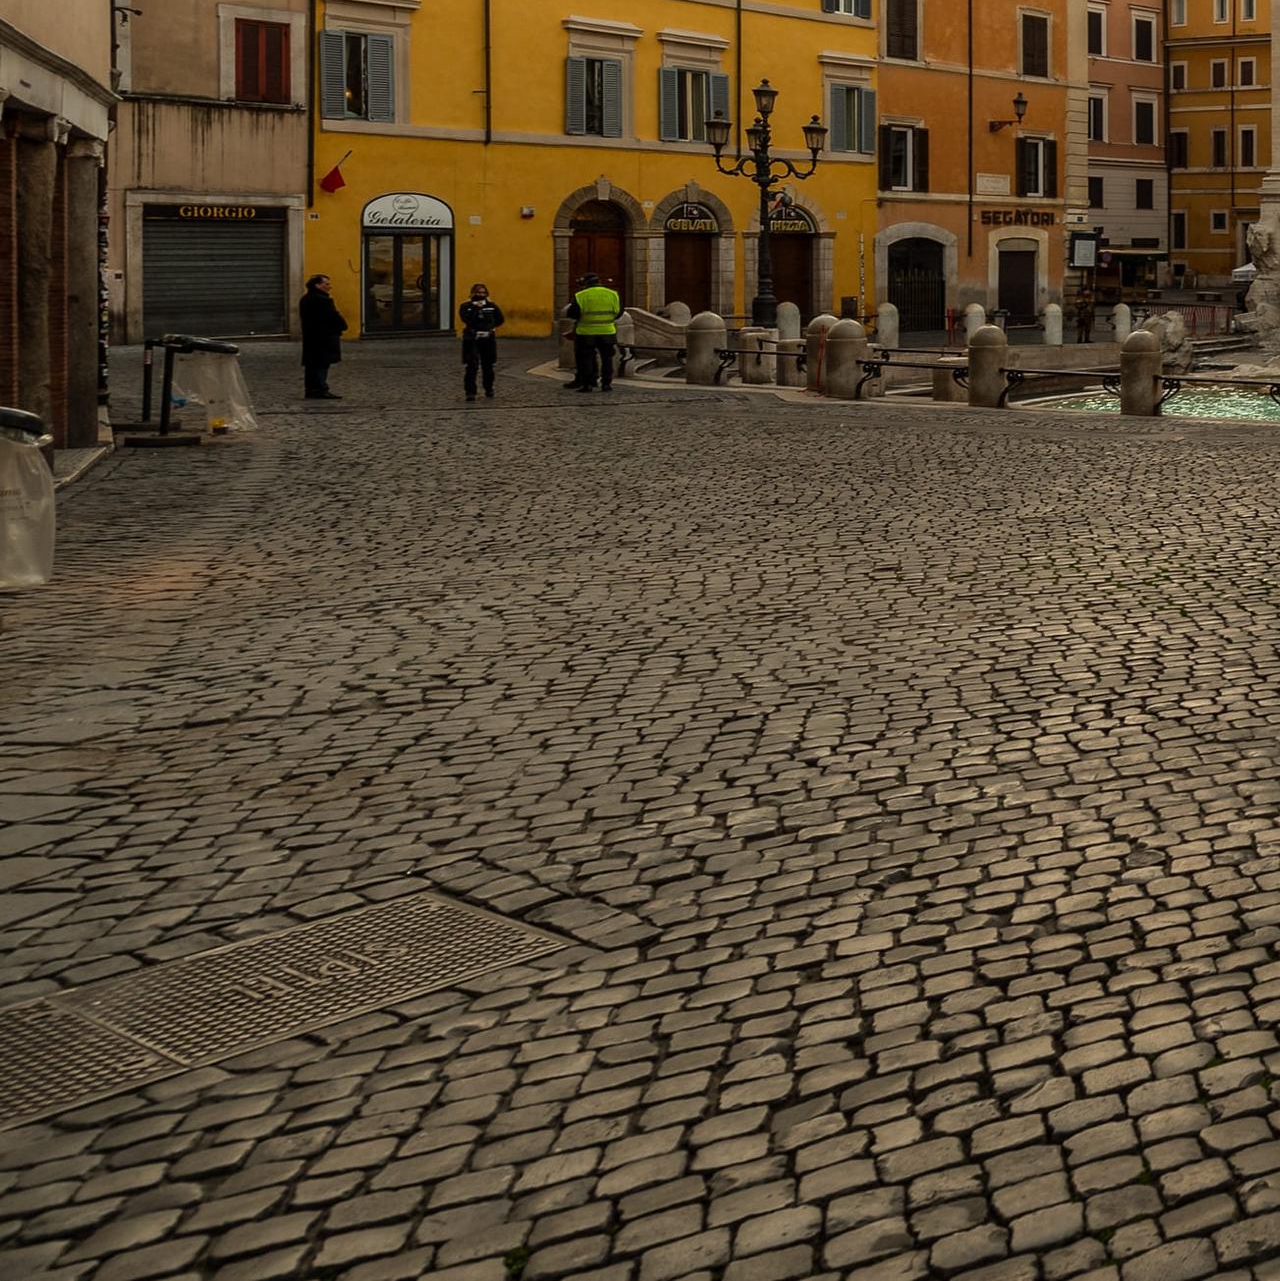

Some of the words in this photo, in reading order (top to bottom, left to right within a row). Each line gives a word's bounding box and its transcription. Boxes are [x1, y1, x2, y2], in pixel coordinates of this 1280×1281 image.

[179, 205, 256, 218] GIORGIO
[368, 210, 442, 226] Gelateria
[981, 208, 1055, 226] SEGATORI
